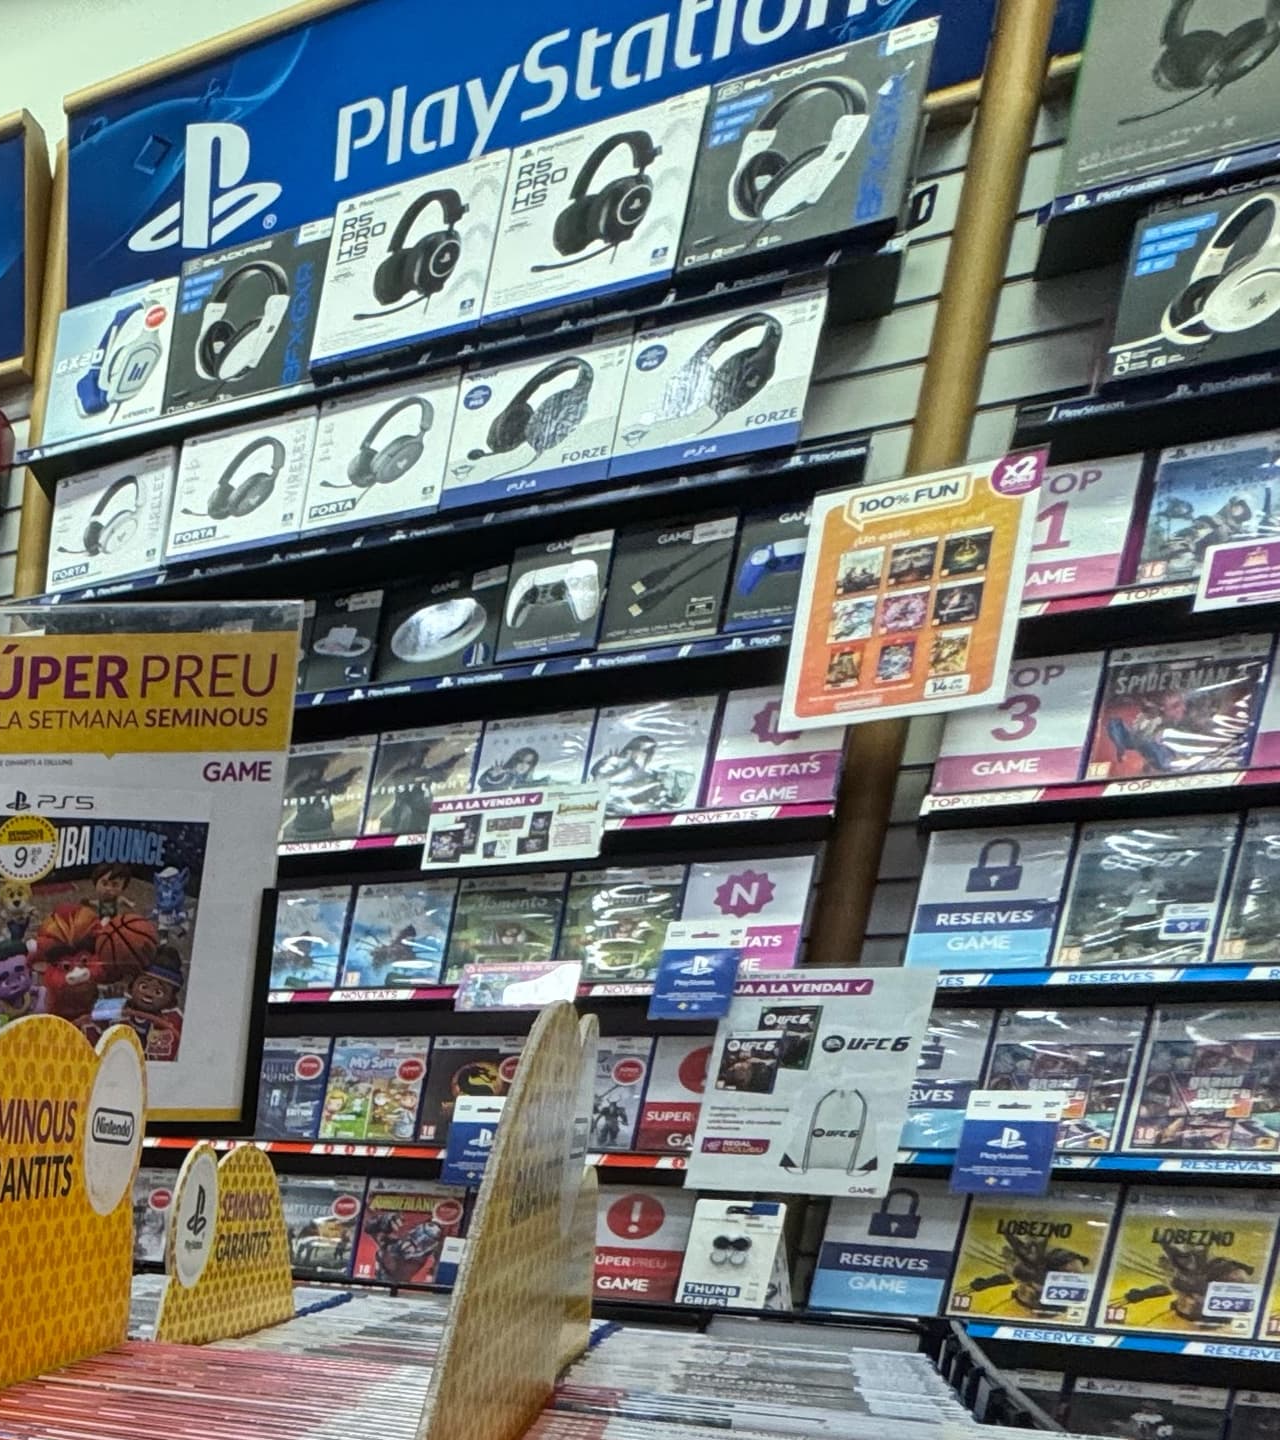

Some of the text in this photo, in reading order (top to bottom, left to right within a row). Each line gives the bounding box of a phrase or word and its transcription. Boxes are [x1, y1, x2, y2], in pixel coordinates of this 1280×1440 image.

[333, 0, 877, 182] PlayStation
[514, 166, 569, 192] PRO
[511, 188, 548, 211] HS
[744, 406, 798, 428] FORZE
[560, 444, 610, 464] FORZE
[859, 481, 959, 513] 100% FUN
[310, 500, 354, 518] FORTA
[1032, 501, 1071, 551] 1
[52, 564, 88, 582] FORTA
[142, 653, 278, 698] PREU
[28, 710, 140, 730] SETMANA
[145, 707, 268, 729] SEMINOUS
[991, 694, 1039, 742] 3
[203, 761, 272, 782] GAME
[727, 760, 821, 781] NOVETATS
[971, 758, 1039, 778] GAME
[37, 795, 95, 811] PS5
[739, 785, 798, 803] GAME
[92, 826, 168, 866] BOUNCE
[936, 908, 1035, 927] RESERVES
[946, 934, 1011, 952] GAME
[770, 983, 790, 994] LA
[792, 982, 850, 994] VENDA!
[997, 1218, 1073, 1239] LOBEZNO
[1152, 1227, 1235, 1247] LOBEZNO
[839, 1252, 930, 1272] RESERVES
[597, 1277, 649, 1293] GAME
[686, 1284, 737, 1296] THUMB
